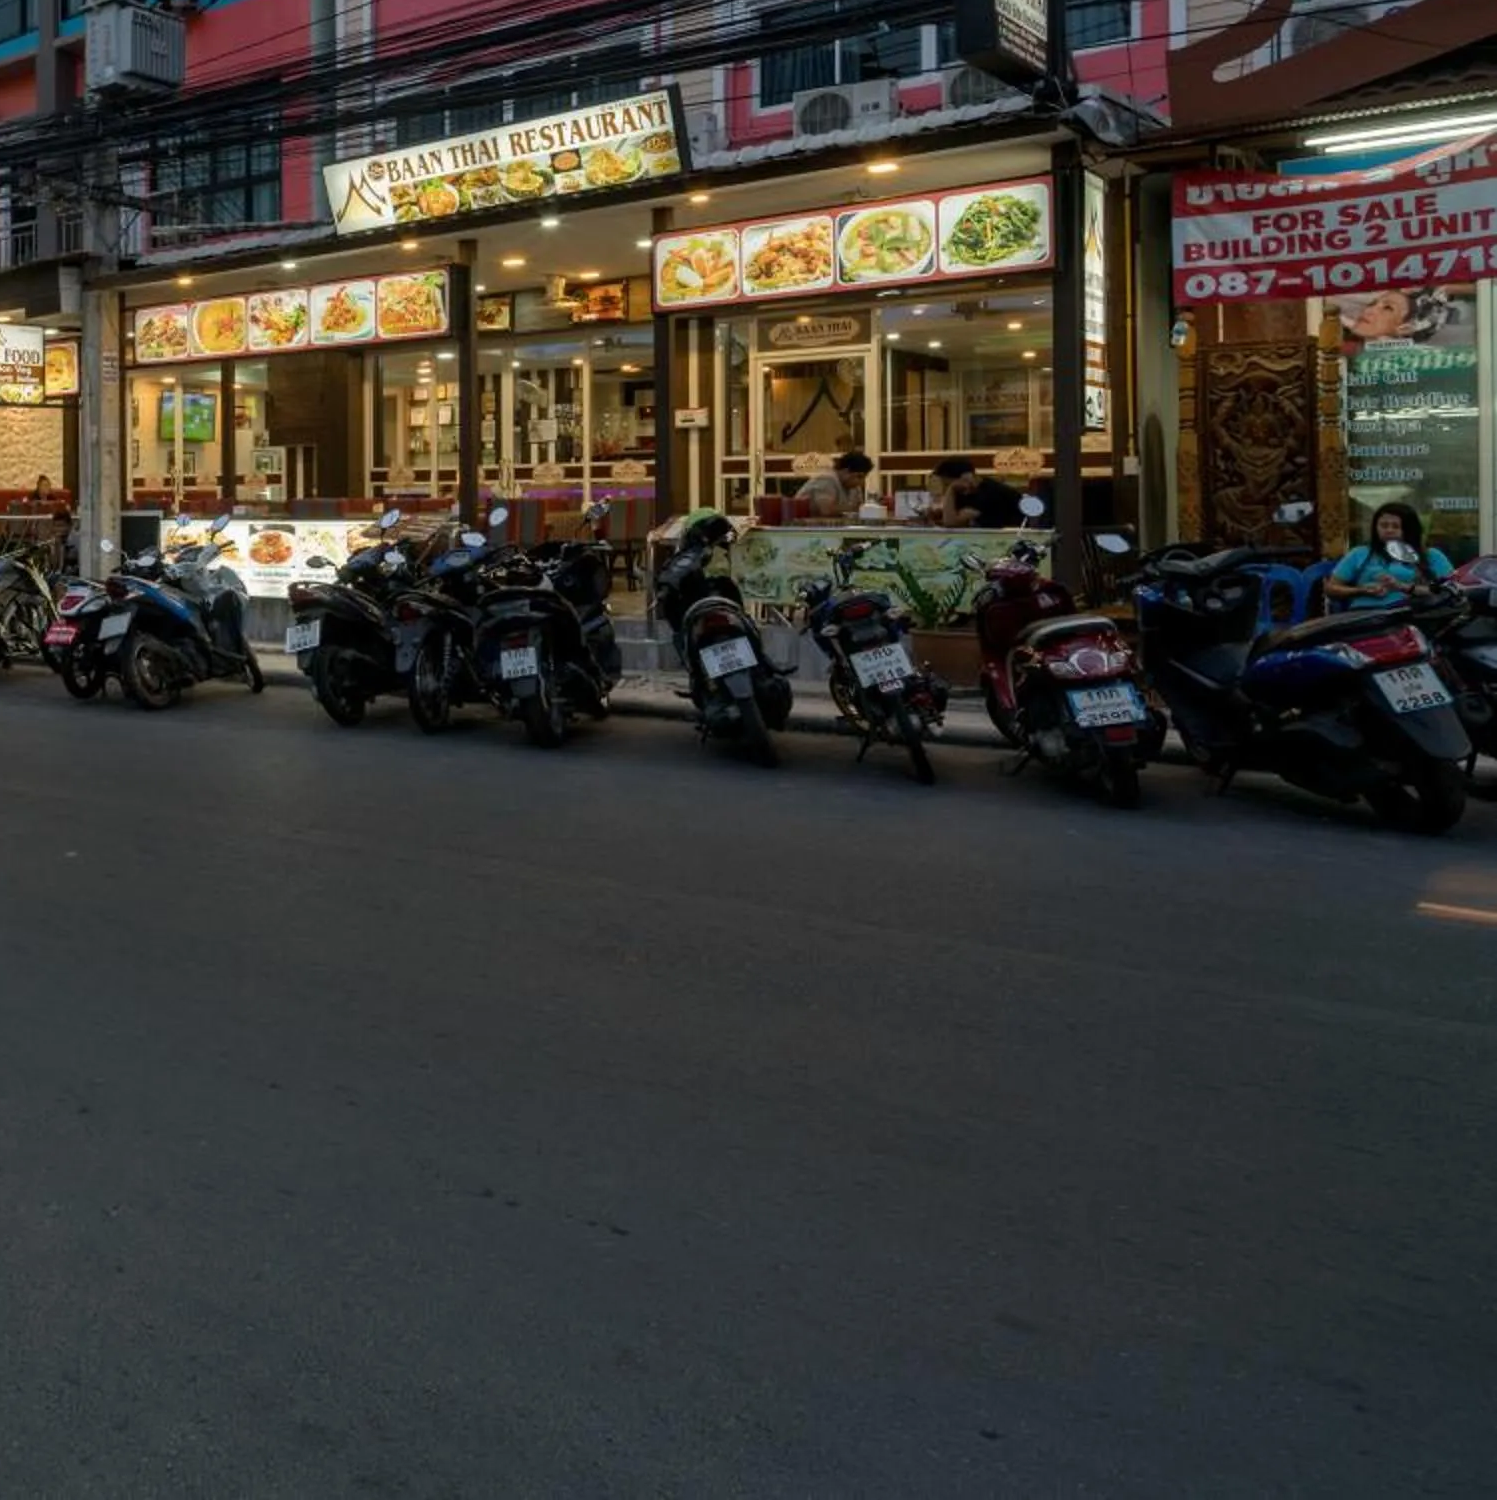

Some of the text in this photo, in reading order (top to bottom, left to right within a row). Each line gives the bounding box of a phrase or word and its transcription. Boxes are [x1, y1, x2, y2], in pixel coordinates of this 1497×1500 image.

[387, 149, 444, 184] BAAN
[447, 138, 502, 171] THAI
[508, 100, 670, 157] RESTAURANT
[1183, 208, 1496, 263] BUILDING 2 UNIT
[1252, 193, 1439, 235] FOR SALE
[3, 347, 40, 365] FOOD
